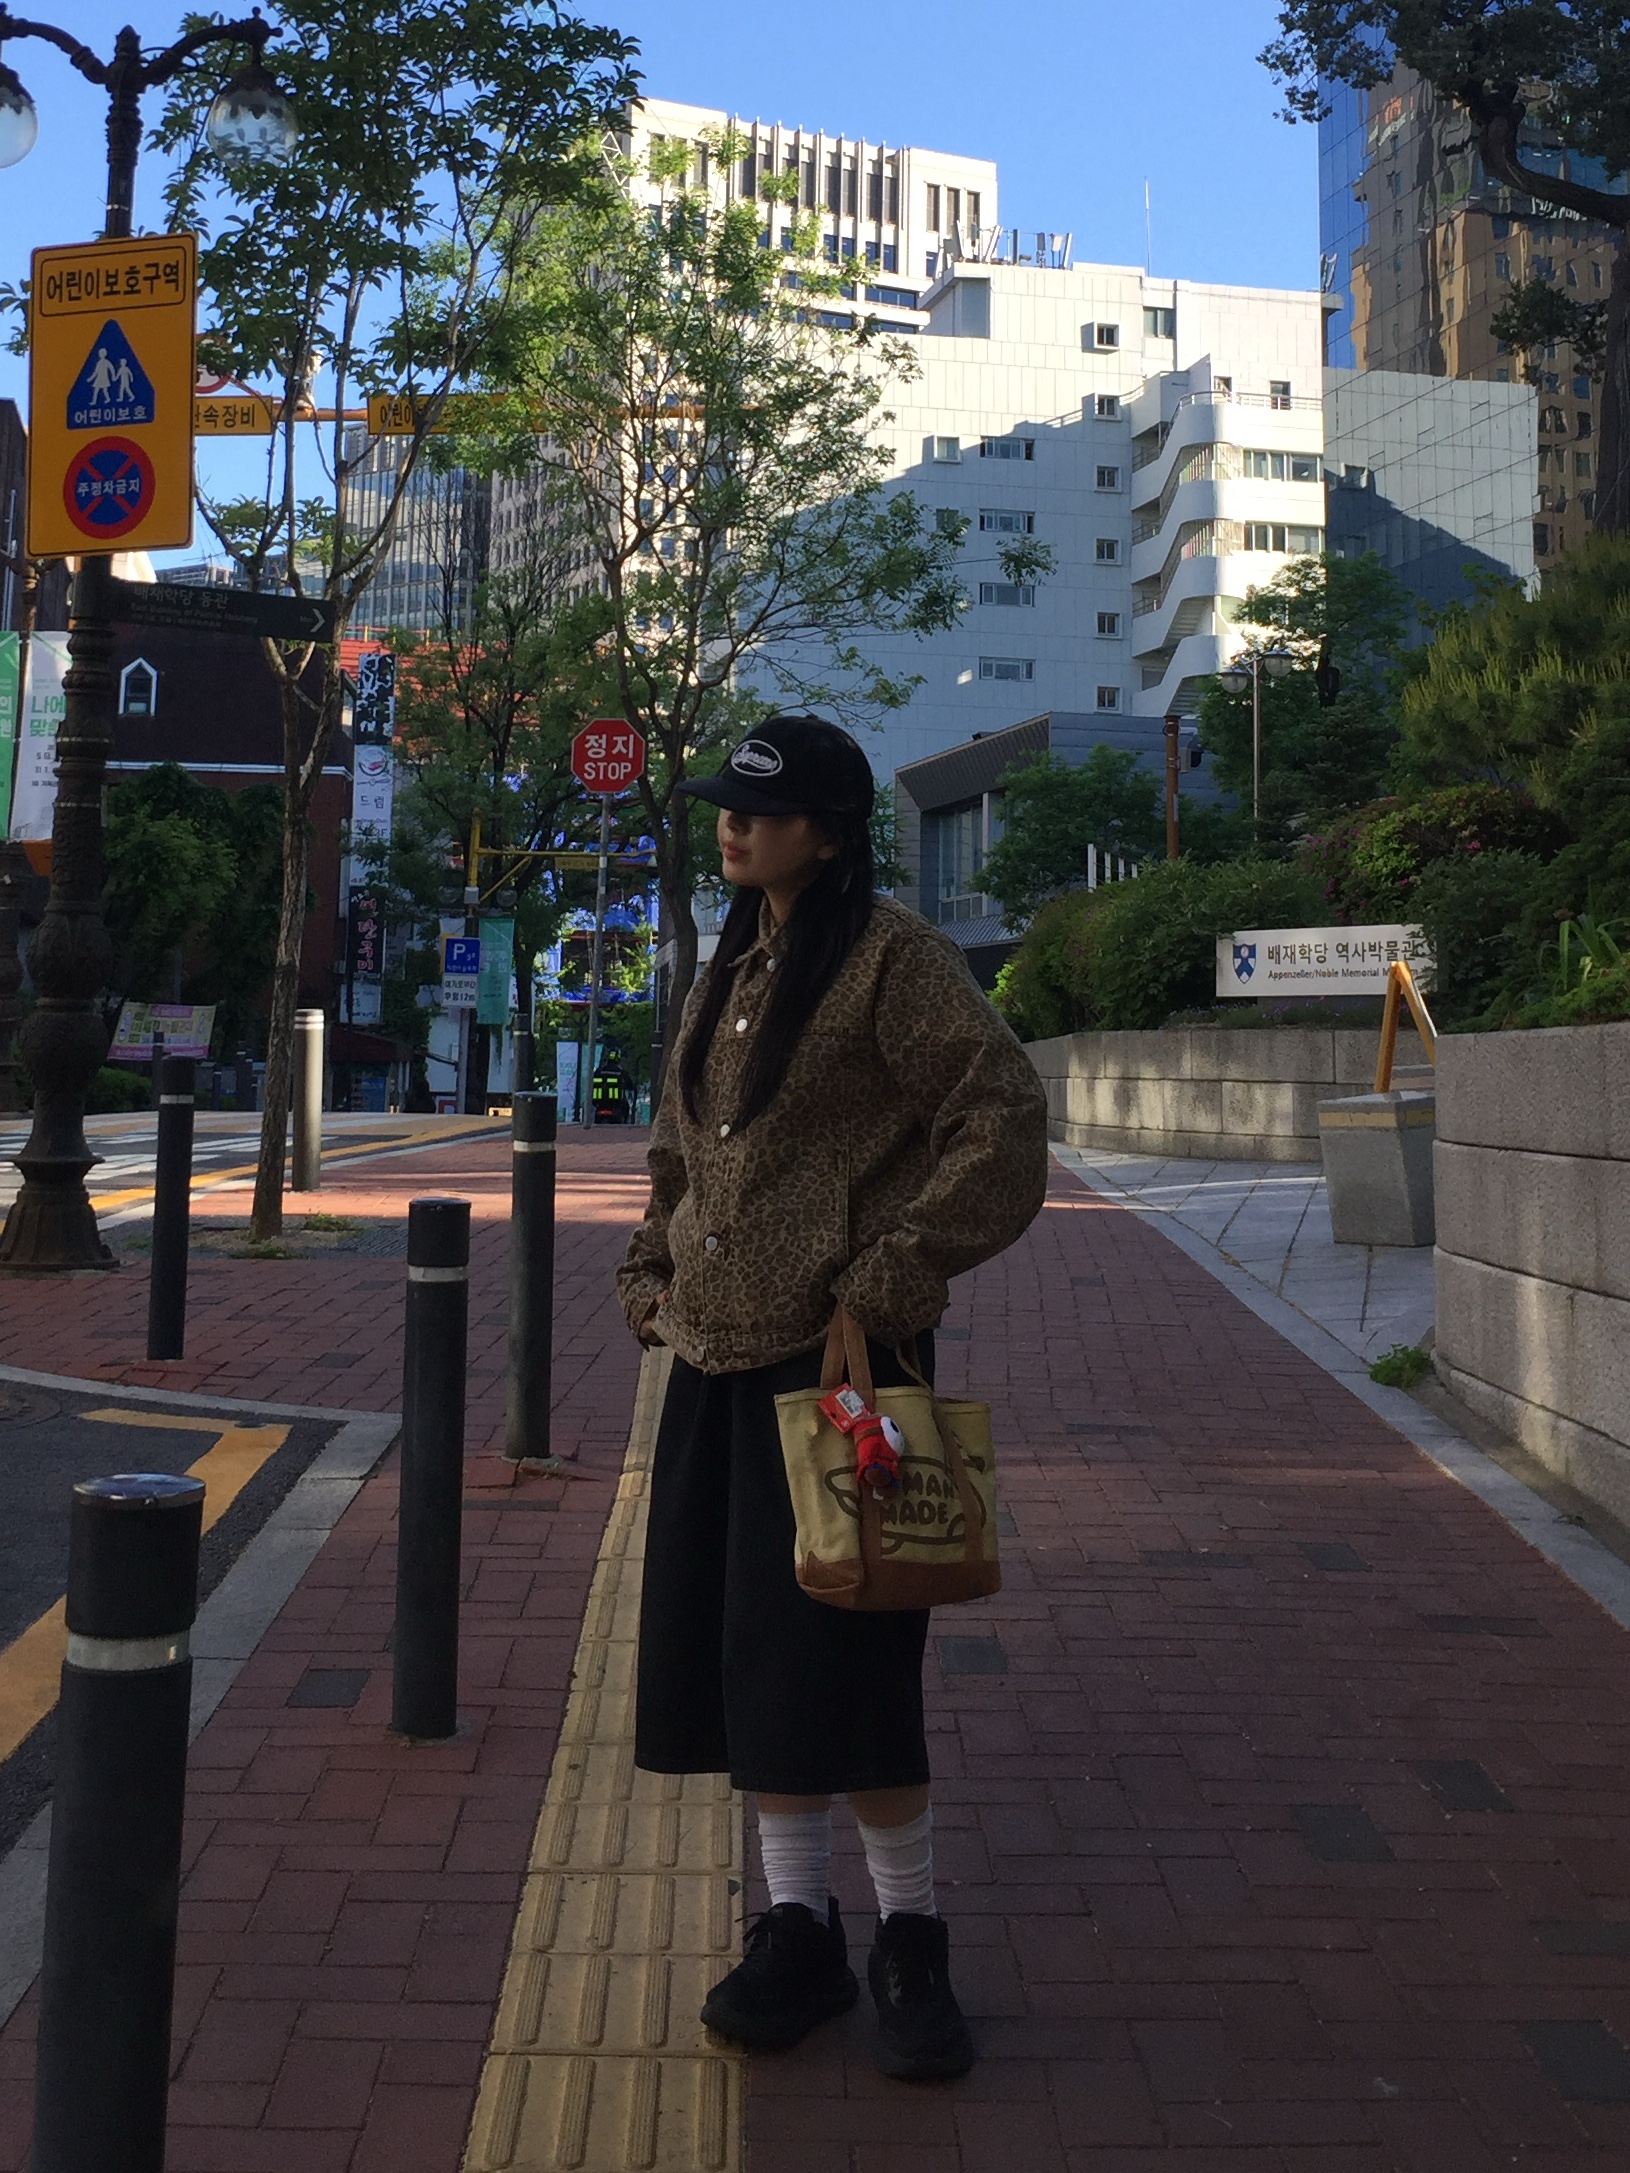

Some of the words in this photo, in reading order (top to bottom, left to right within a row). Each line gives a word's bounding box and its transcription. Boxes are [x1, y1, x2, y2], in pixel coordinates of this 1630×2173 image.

[46, 260, 181, 302] 어린이보호구역
[74, 405, 147, 424] 어린이보호
[77, 478, 140, 497] 주정차금지
[134, 585, 195, 606] 배재학당
[584, 733, 634, 759] 정지
[583, 761, 632, 780] STOP
[453, 943, 467, 961] P
[1267, 942, 1329, 965] 배재학당
[1335, 939, 1418, 963] 역사박물관
[1341, 967, 1380, 978] Memorial
[902, 1470, 955, 1498] MAN
[880, 1499, 949, 1526] MADE
